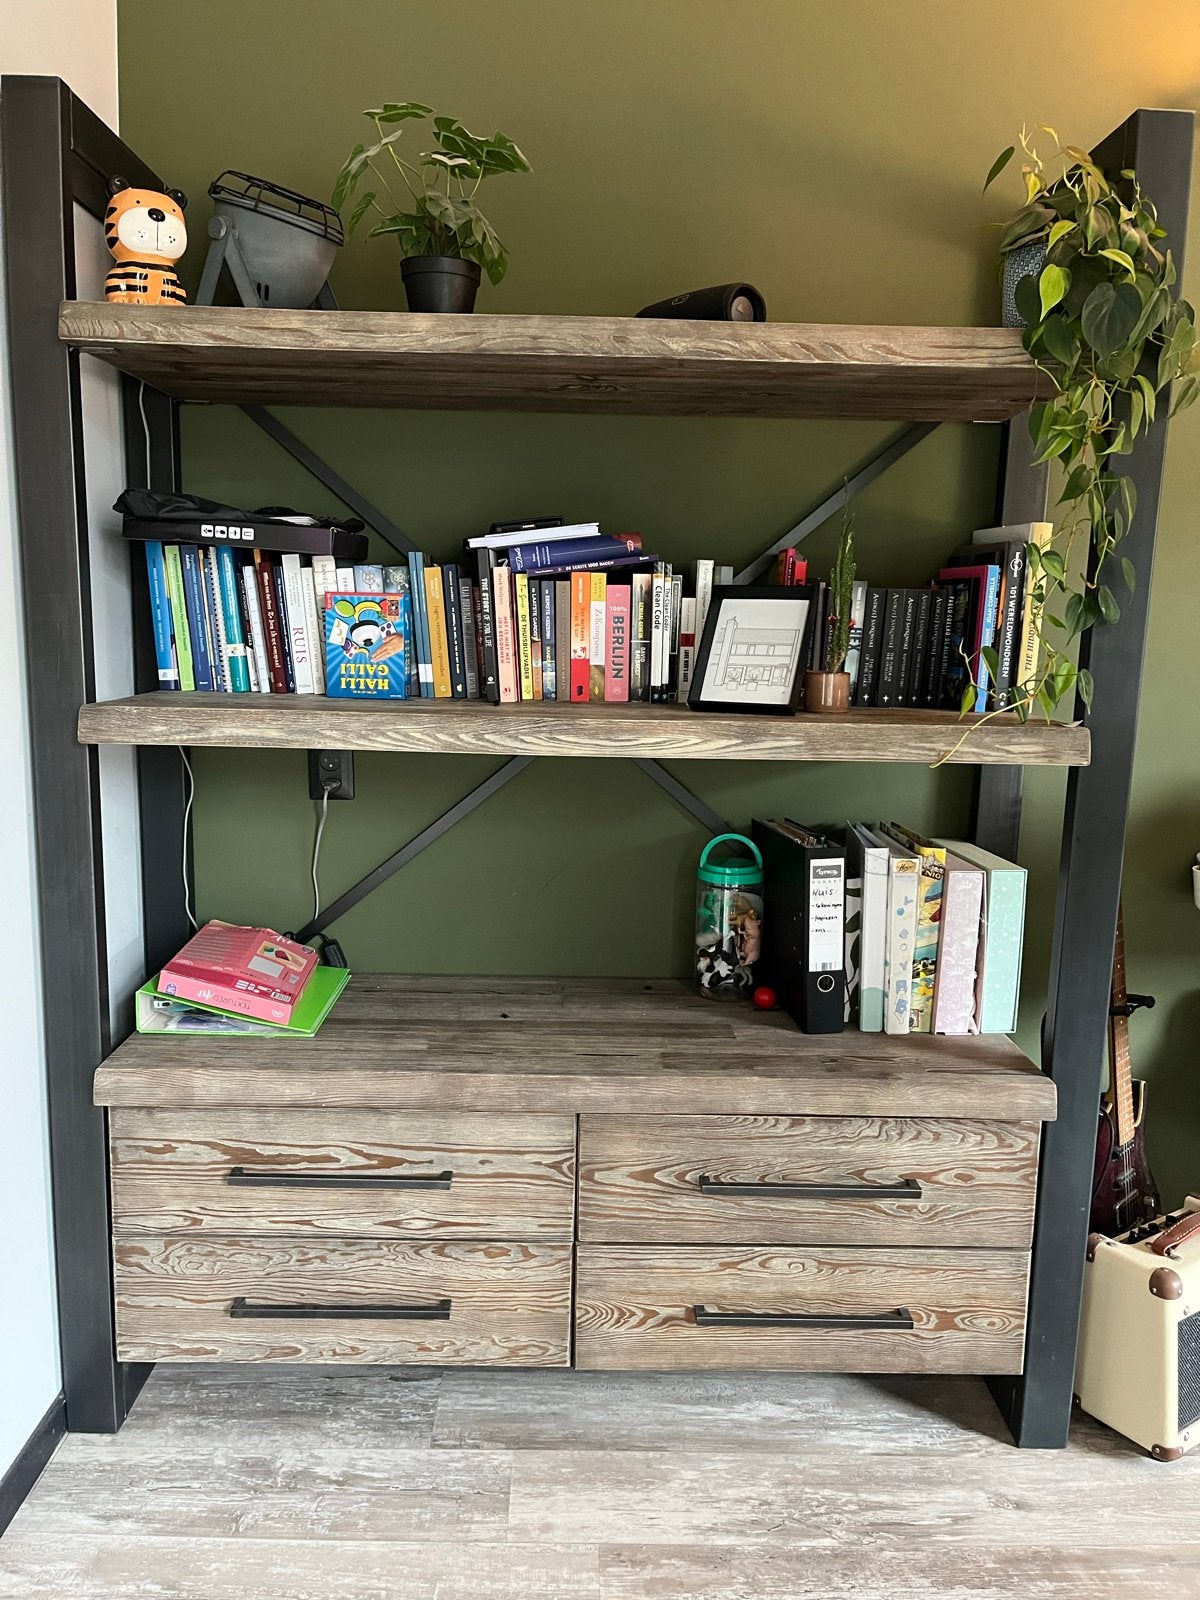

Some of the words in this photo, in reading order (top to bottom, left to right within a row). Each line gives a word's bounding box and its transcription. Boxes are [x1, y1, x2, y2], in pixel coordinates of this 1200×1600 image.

[481, 578, 489, 591] THE
[1009, 586, 1017, 599] 101
[482, 592, 490, 612] STORY
[654, 586, 662, 608] Clean
[871, 593, 880, 618] ANDRZEJ
[891, 593, 900, 618] ANDRZEJ
[906, 597, 914, 620] ANDRZEJ
[920, 594, 928, 618] ANDRZEJ
[483, 614, 490, 622] OF
[521, 614, 527, 624] DE
[654, 609, 662, 630] Code
[934, 596, 943, 623] ANDRZEJ
[593, 608, 603, 657] Zelfcompassie
[888, 619, 896, 648] SAPKOWSKI
[903, 622, 911, 649] SAPKOWSKI
[945, 614, 953, 636] COELHO
[293, 627, 307, 664] RUIS
[611, 616, 624, 679] BERLIJN
[847, 628, 863, 652] HEX
[931, 624, 940, 654] SAPKOWSKI
[1002, 600, 1016, 678] WERELDWONDEREN
[522, 624, 530, 680] THUISBLIJFVADER
[1024, 654, 1033, 672] THE
[340, 663, 390, 676] GALLI
[437, 652, 445, 677] opvoeden
[340, 677, 390, 690] HALLI
[214, 995, 251, 1010] TEXTURED
